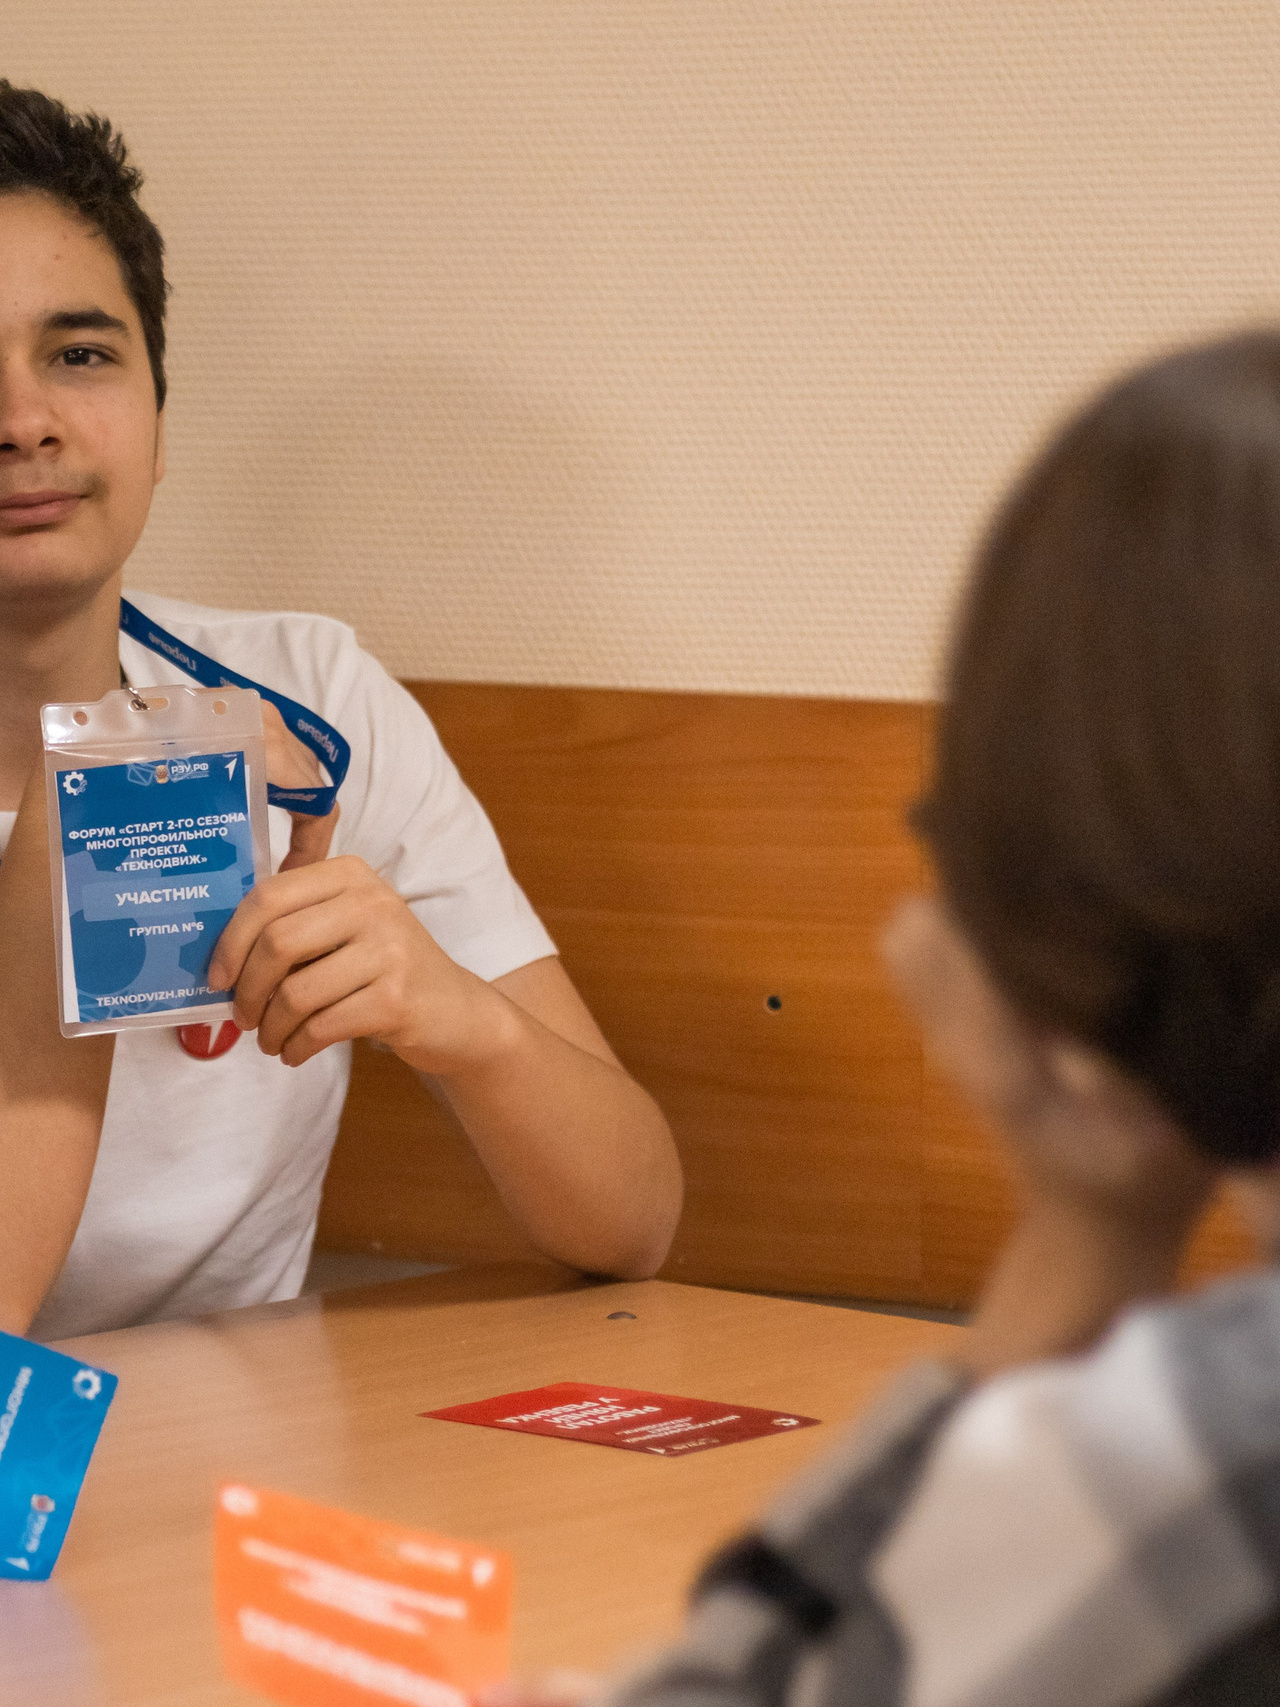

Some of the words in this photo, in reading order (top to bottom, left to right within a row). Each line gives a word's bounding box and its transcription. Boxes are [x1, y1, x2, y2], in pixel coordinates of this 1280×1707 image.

[68, 825, 116, 841] ФОРУМ
[118, 820, 164, 836] «СТАРТ
[166, 817, 195, 831] 2-ГО
[197, 811, 247, 828] СЕЗОНА
[86, 827, 229, 851] МНОГОПРОФИЛЬНОГО
[130, 844, 188, 859] ПРОЕКТА
[114, 854, 208, 872] «ТЕХНОДВИЖ»
[115, 885, 210, 906] УЧАСТНИК
[129, 923, 180, 937] ГРУППА
